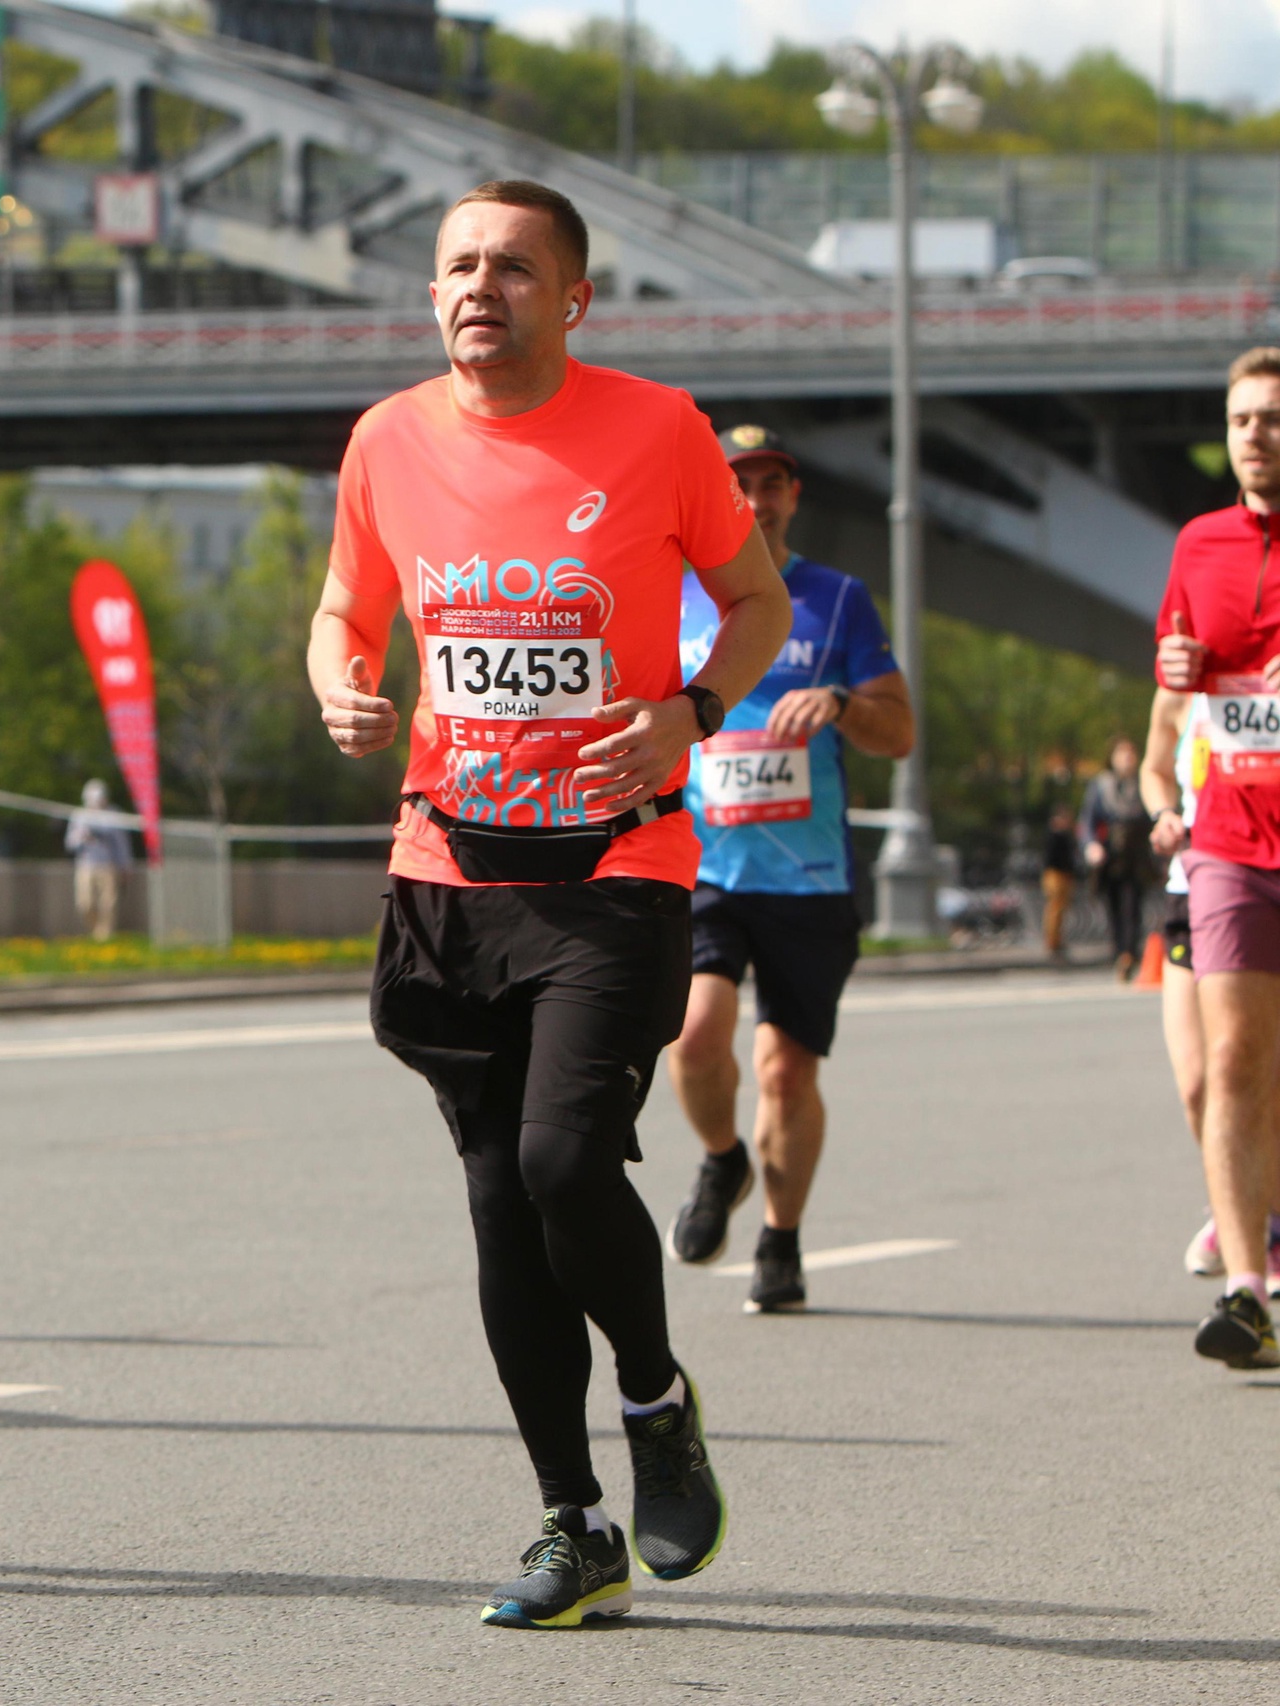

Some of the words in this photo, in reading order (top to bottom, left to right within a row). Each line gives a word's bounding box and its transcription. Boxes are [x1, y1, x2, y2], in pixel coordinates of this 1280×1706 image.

[440, 609, 501, 618] МОСКОВСКИЙ
[519, 611, 548, 628] 21,1
[552, 611, 582, 626] КМ
[441, 626, 485, 634] МАРАФОН
[558, 628, 582, 636] 2022
[437, 645, 590, 696] 13453
[483, 701, 540, 717] РОМАН
[1224, 701, 1280, 733] 846
[449, 718, 468, 746] E
[716, 755, 794, 789] 7544
